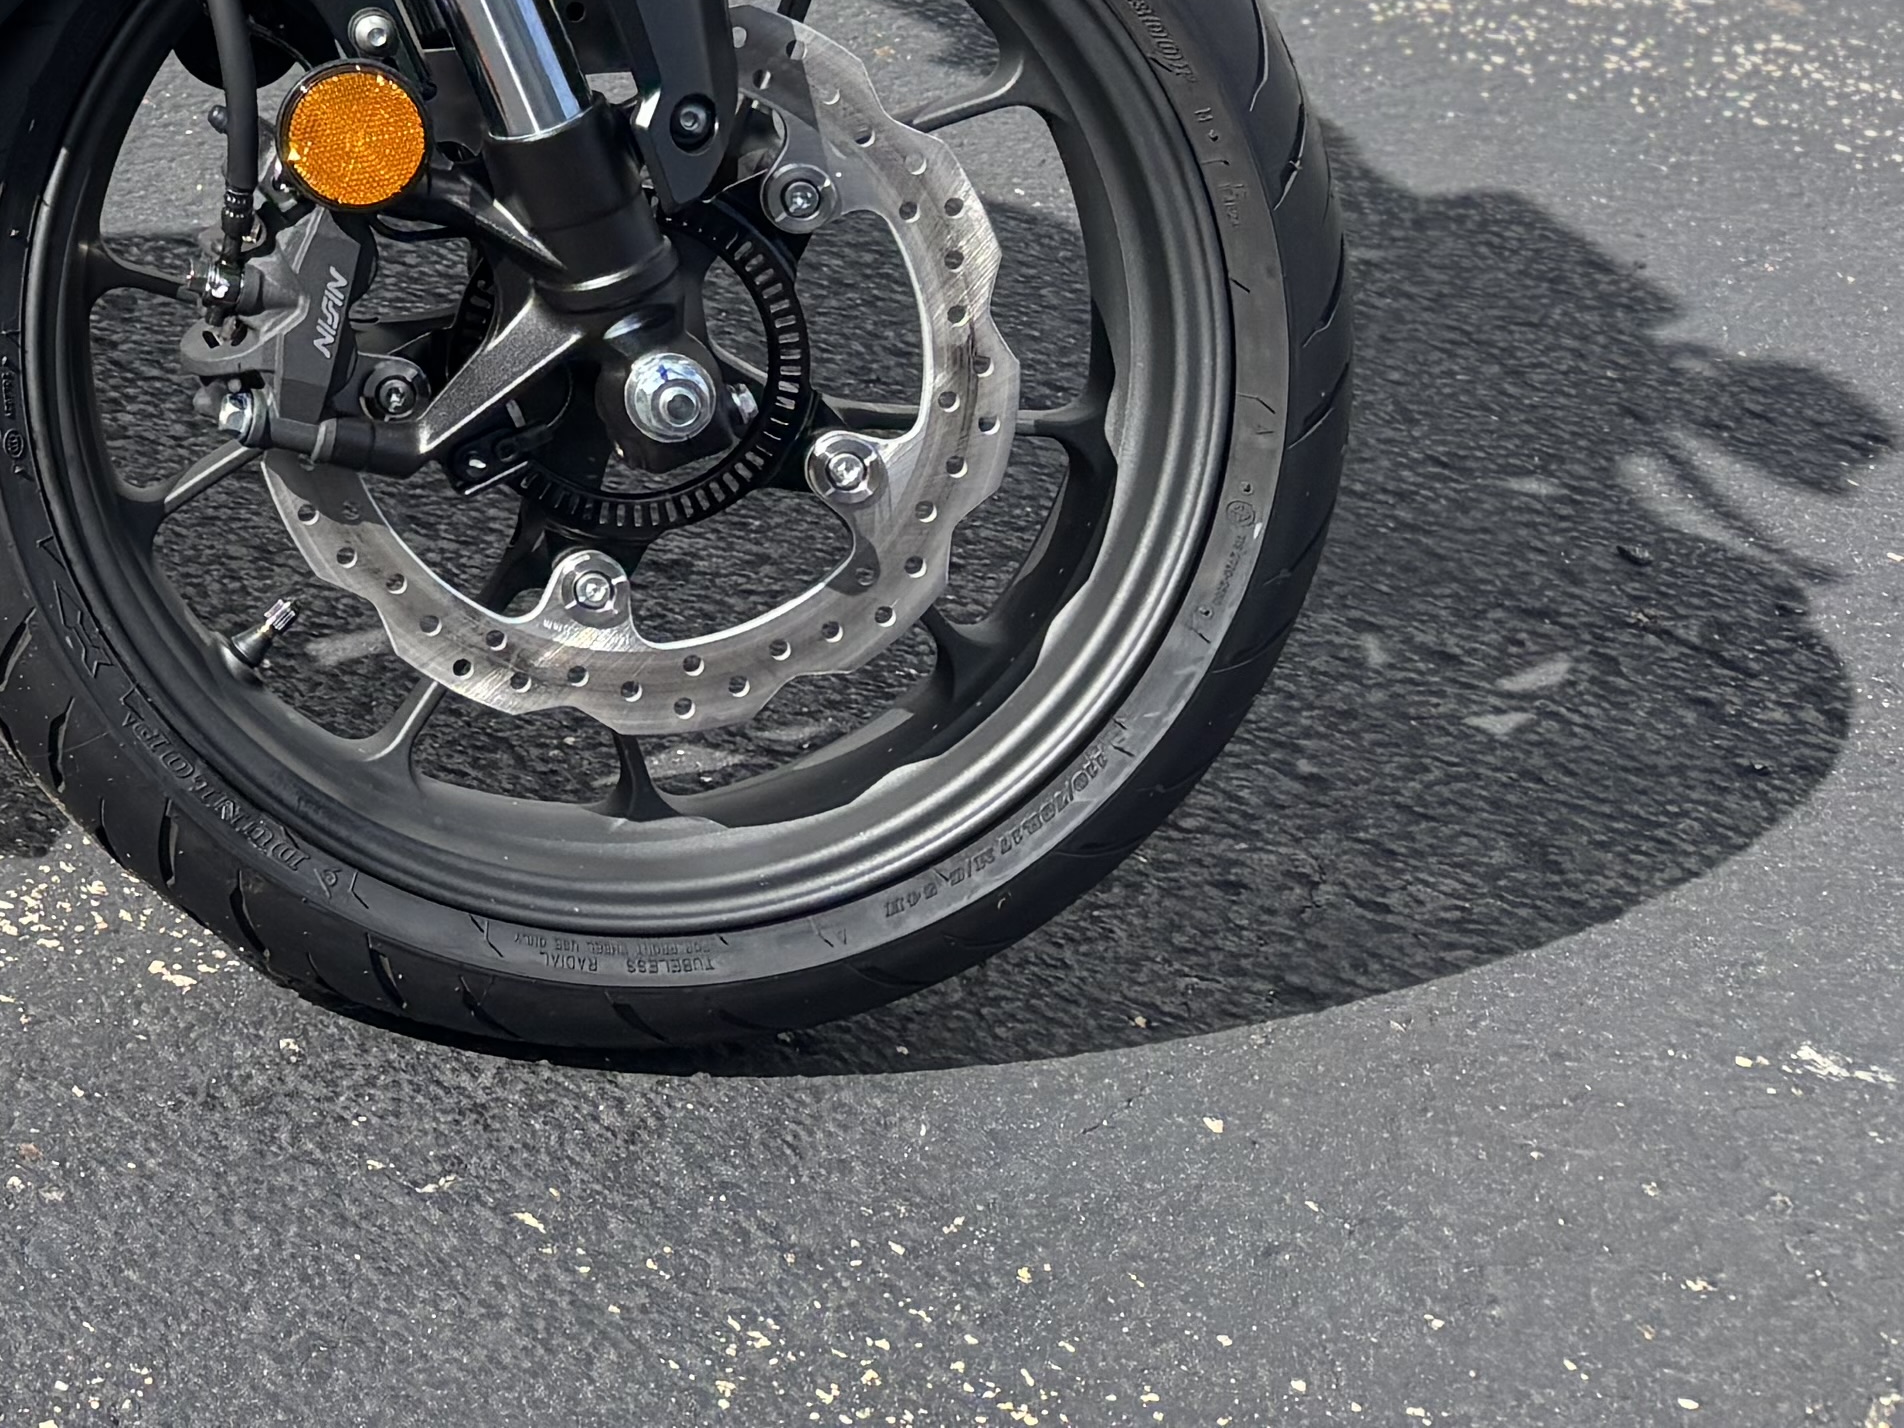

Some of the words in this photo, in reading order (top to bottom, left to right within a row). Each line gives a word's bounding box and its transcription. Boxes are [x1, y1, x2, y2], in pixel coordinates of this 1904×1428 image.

[131, 720, 311, 872] DUNLOP
[539, 951, 598, 973] RADIAL
[626, 956, 716, 975] TUBELESS
